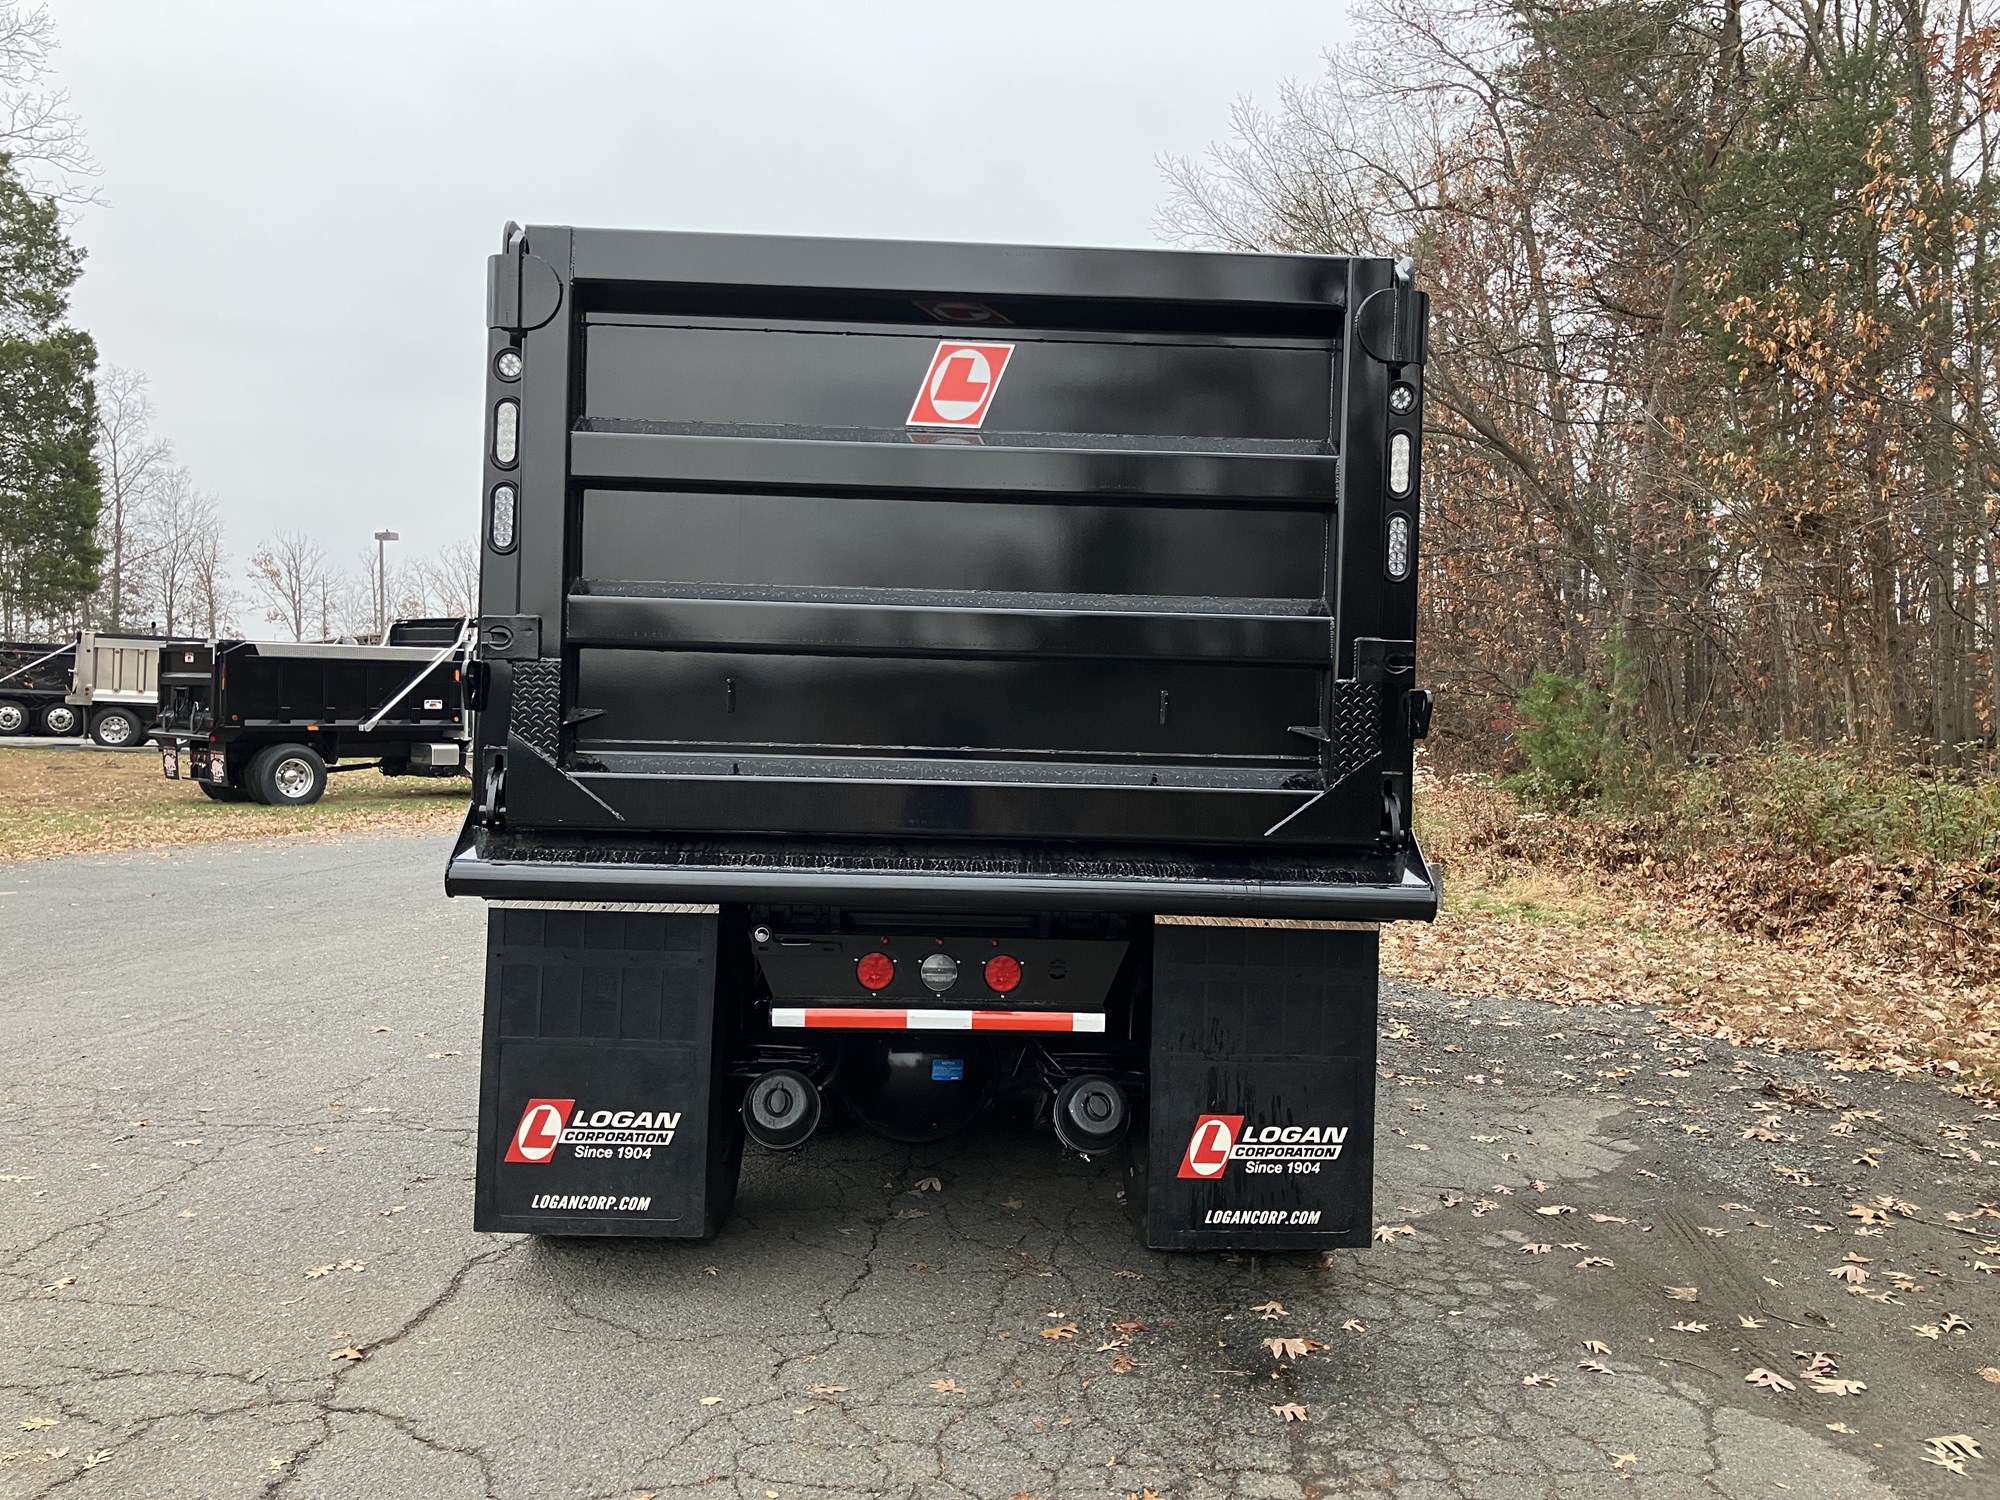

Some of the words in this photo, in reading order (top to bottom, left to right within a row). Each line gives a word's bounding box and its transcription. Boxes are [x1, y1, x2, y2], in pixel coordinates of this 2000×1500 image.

[572, 1110, 681, 1129] LOGAN
[564, 1132, 668, 1143] CORPORATION
[1242, 1127, 1348, 1143] LOGAN
[574, 1145, 613, 1158] Since
[617, 1147, 652, 1159] 1904
[1235, 1147, 1336, 1157] CORPORATION
[1245, 1161, 1282, 1173] Since
[1287, 1162, 1320, 1174] 1904
[532, 1195, 651, 1211] LOGANCORP.COM
[1205, 1210, 1321, 1224] LOGANCORP.COM
